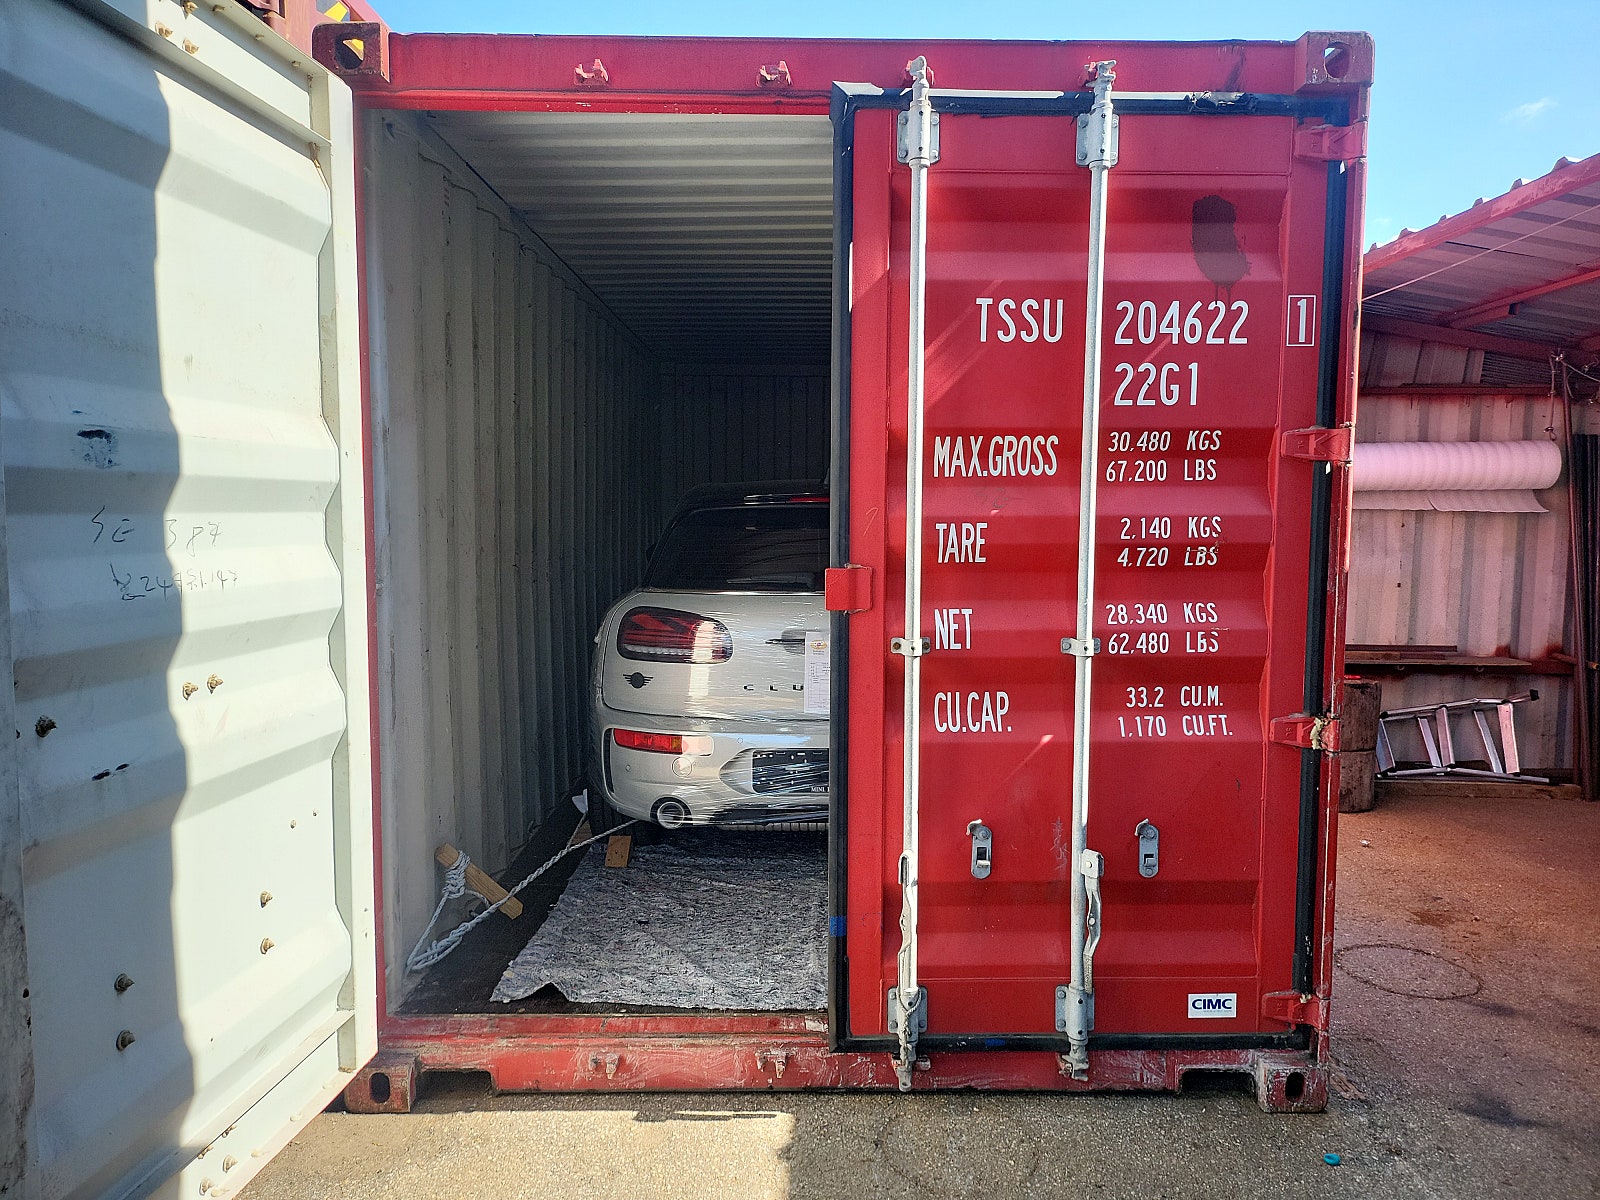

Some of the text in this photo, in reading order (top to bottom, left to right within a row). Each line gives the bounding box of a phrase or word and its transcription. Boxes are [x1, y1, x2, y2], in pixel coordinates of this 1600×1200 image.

[976, 297, 1063, 342] TSSU
[1114, 300, 1249, 344] 204622
[1113, 362, 1198, 406] 22G1
[933, 435, 1059, 478] MAX.GROSS
[1186, 430, 1222, 451] KGS
[1184, 459, 1217, 481] LBS
[936, 522, 987, 563] TARE
[1188, 516, 1221, 538] KGS
[1184, 546, 1218, 566] LBS
[934, 608, 973, 649] NET
[1183, 602, 1218, 623] KGS
[1186, 631, 1219, 653] LBS
[934, 685, 1223, 732] CU.CAP. 33.2 CU.M.
[1182, 714, 1233, 736] CU.FT.
[1191, 998, 1233, 1010] CIMC
